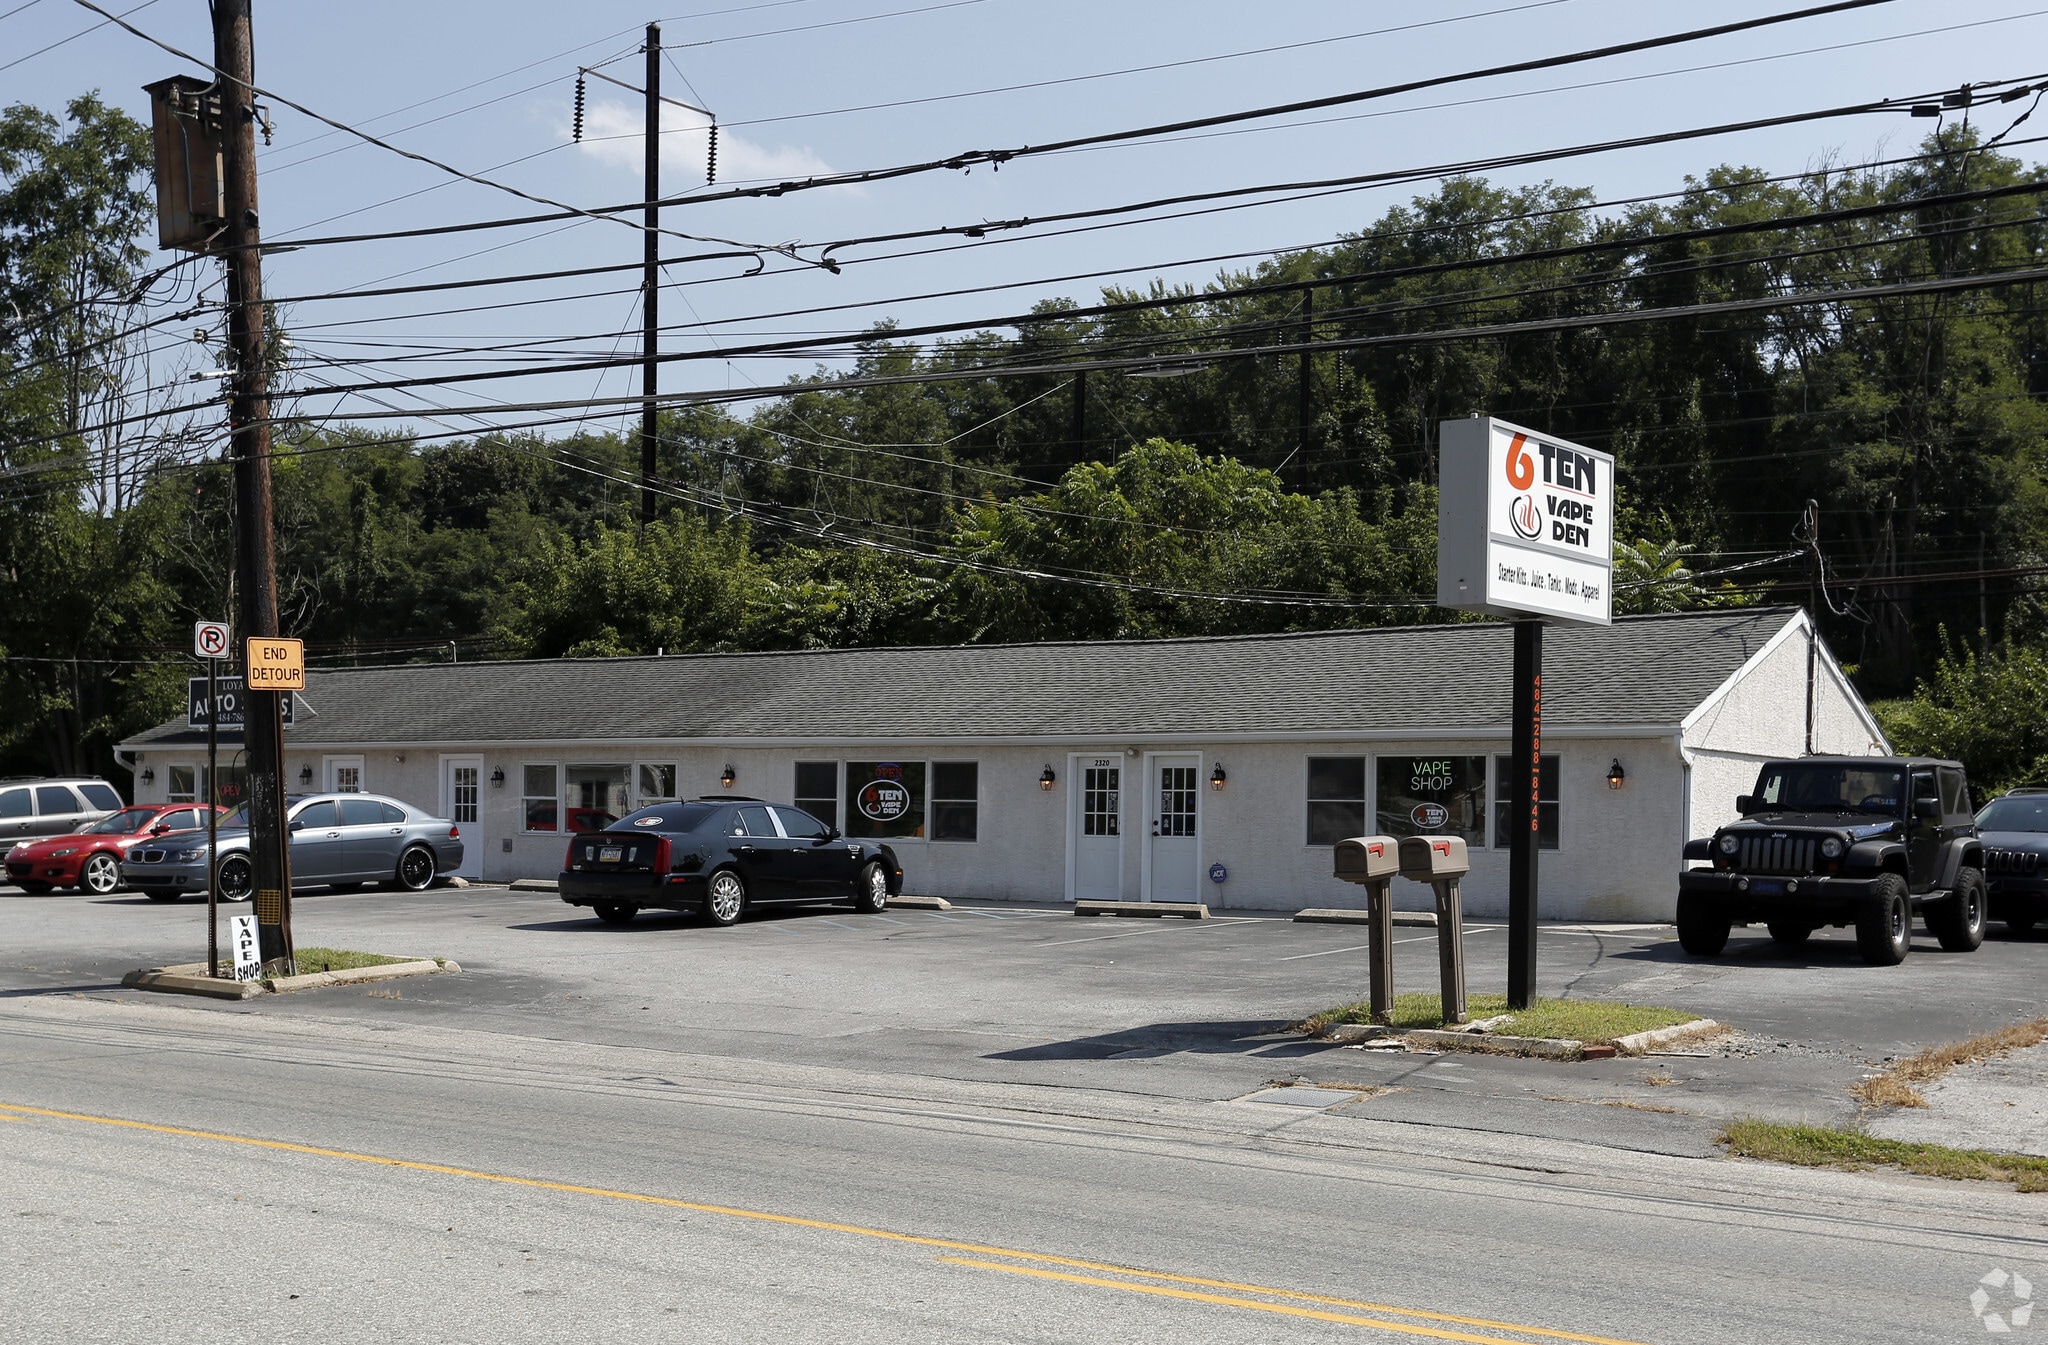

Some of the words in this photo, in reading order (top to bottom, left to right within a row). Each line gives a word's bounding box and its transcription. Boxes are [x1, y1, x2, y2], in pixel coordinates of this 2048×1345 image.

[1505, 432, 1534, 490] 6
[1539, 443, 1595, 495] TEN
[1546, 494, 1593, 525] VAPE
[1552, 520, 1589, 548] DEN
[1498, 562, 1516, 583] Starter
[1531, 570, 1544, 589] Juice
[1548, 573, 1561, 592] Tanks
[1565, 577, 1577, 596] Mods
[1581, 581, 1599, 603] Apparel
[263, 647, 287, 660] END
[252, 668, 300, 681] DETOUR
[222, 681, 244, 691] LOYA
[1531, 675, 1541, 831] 484-288-8446
[875, 767, 903, 778] OPEN
[1412, 761, 1452, 776] VAPE
[1411, 776, 1453, 791] SHOP
[878, 790, 902, 800] TEN
[239, 917, 253, 961] VAPE
[237, 961, 260, 983] SHOP
